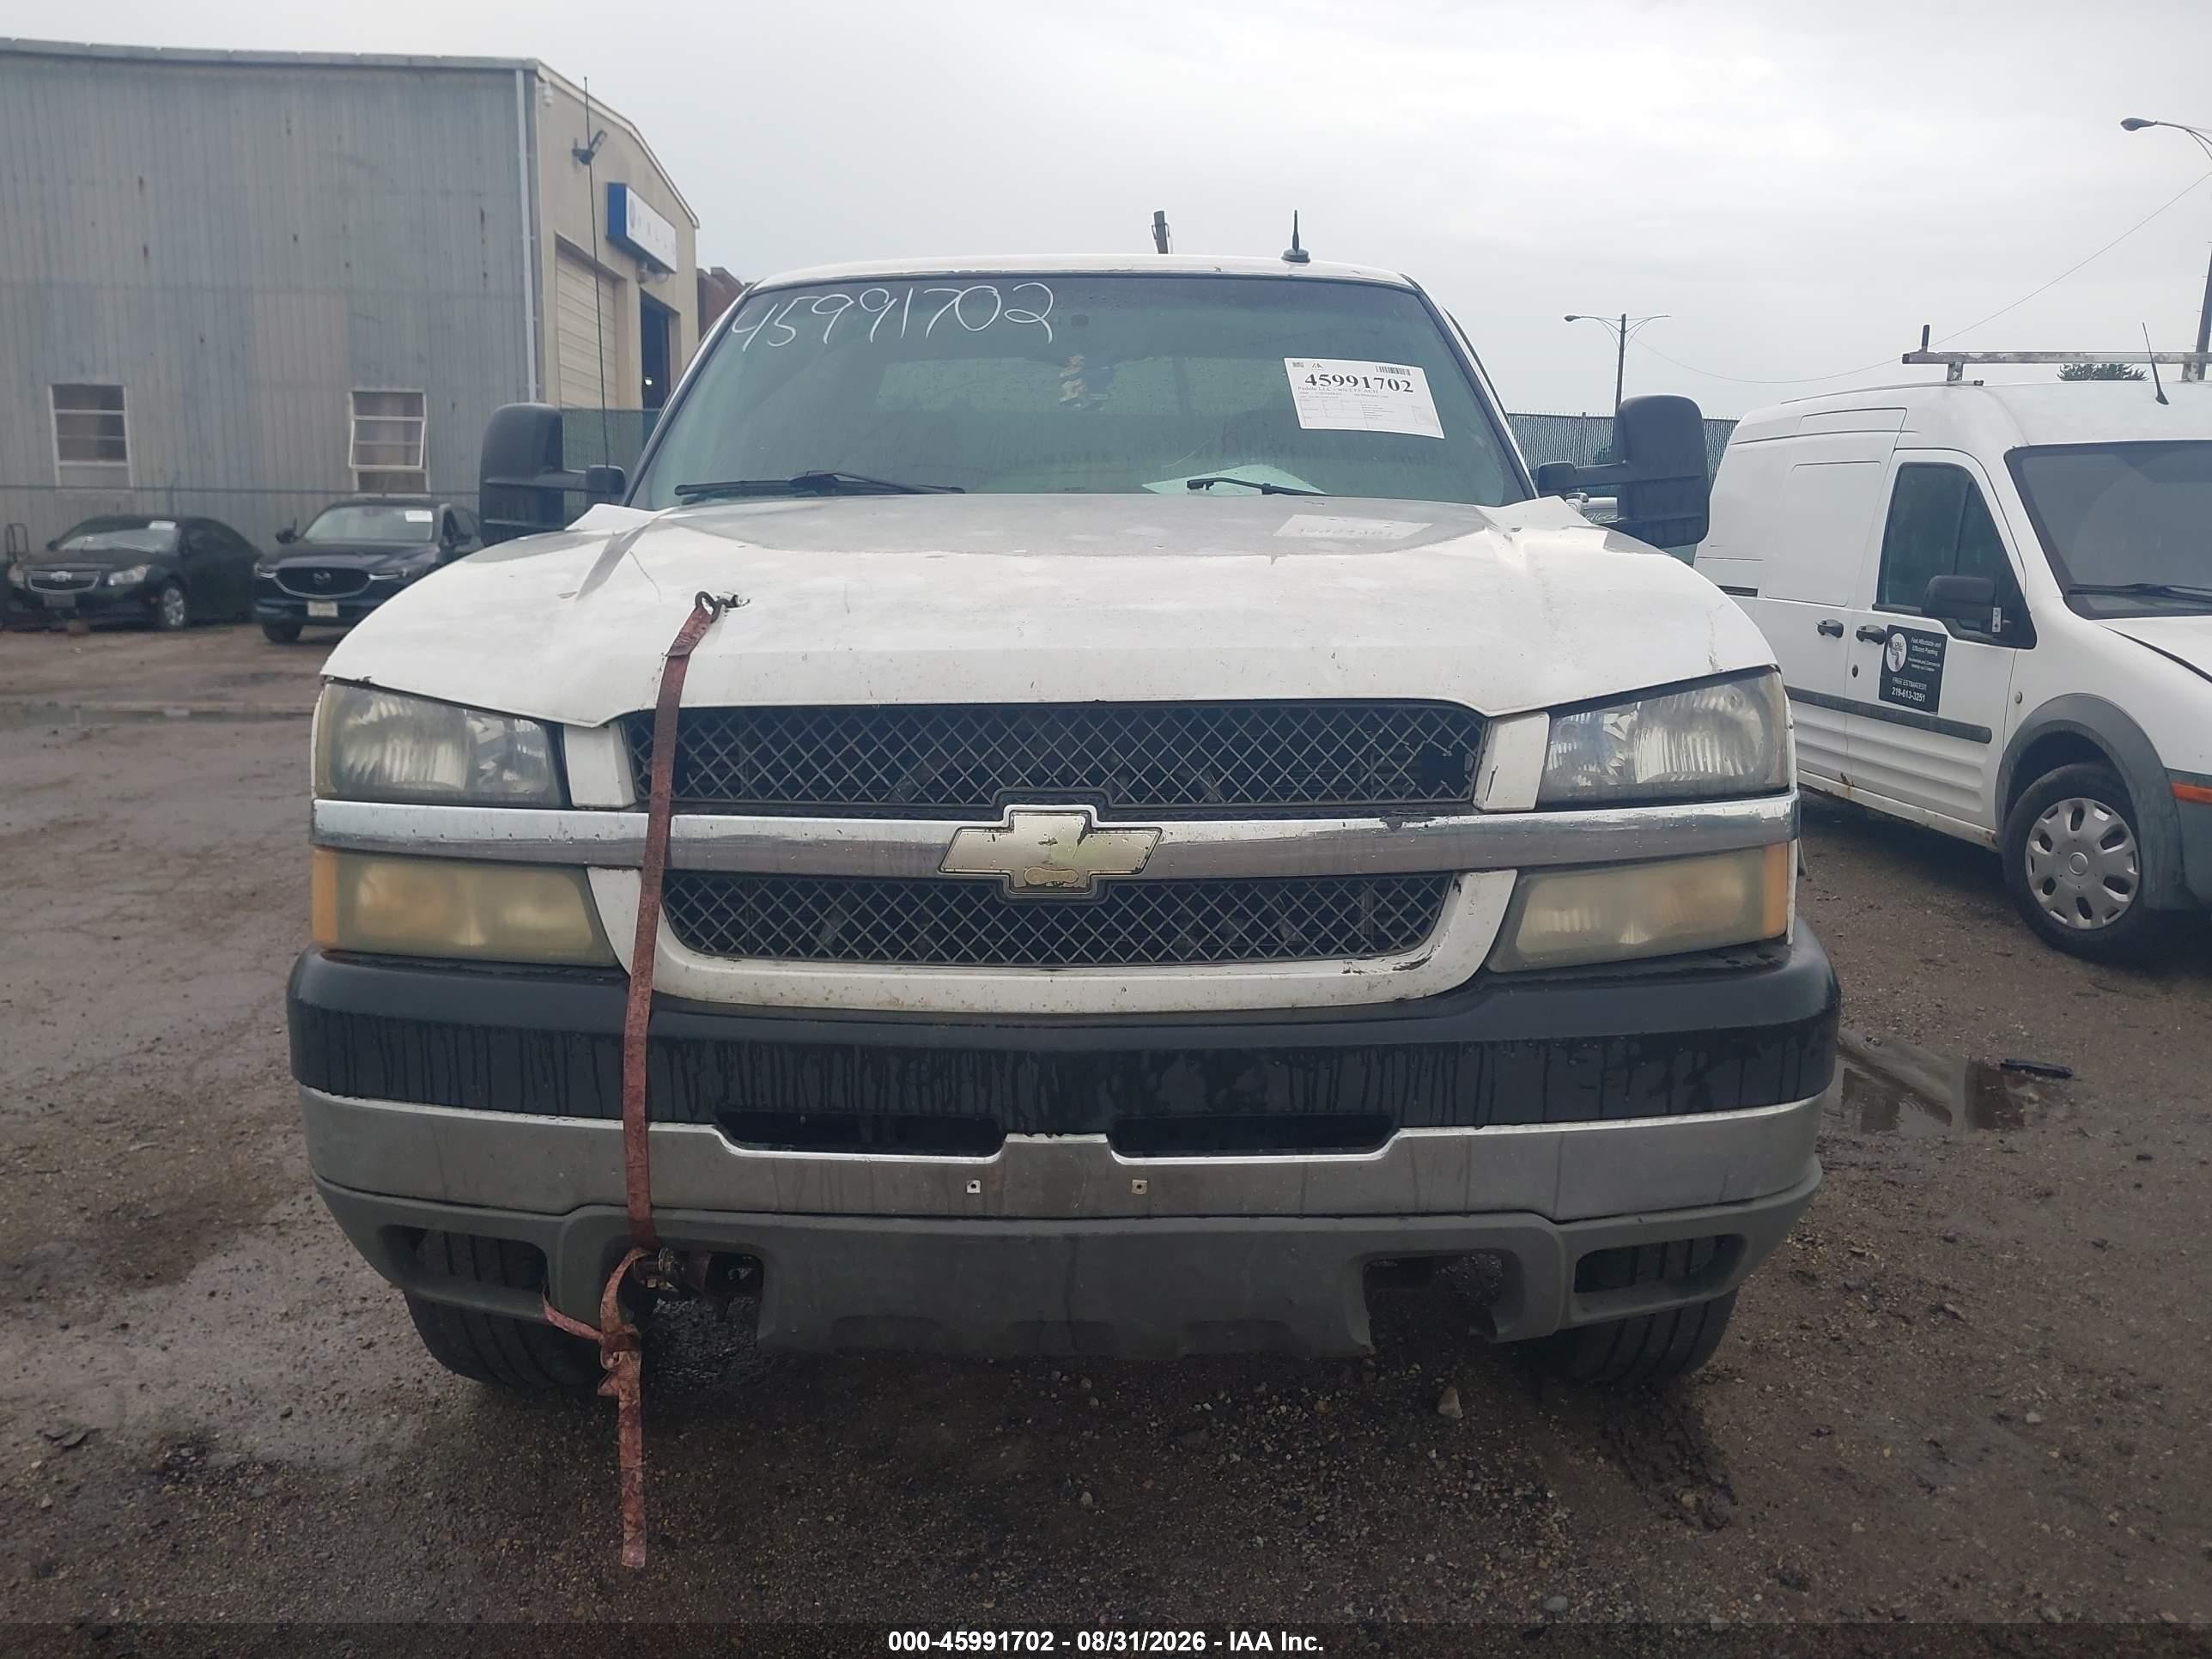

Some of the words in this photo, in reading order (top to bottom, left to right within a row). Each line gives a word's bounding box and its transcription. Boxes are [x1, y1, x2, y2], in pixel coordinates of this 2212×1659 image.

[732, 282, 1054, 352] 45991702
[1304, 374, 1413, 393] 45991702
[1891, 686, 1926, 702] 219-613-3251
